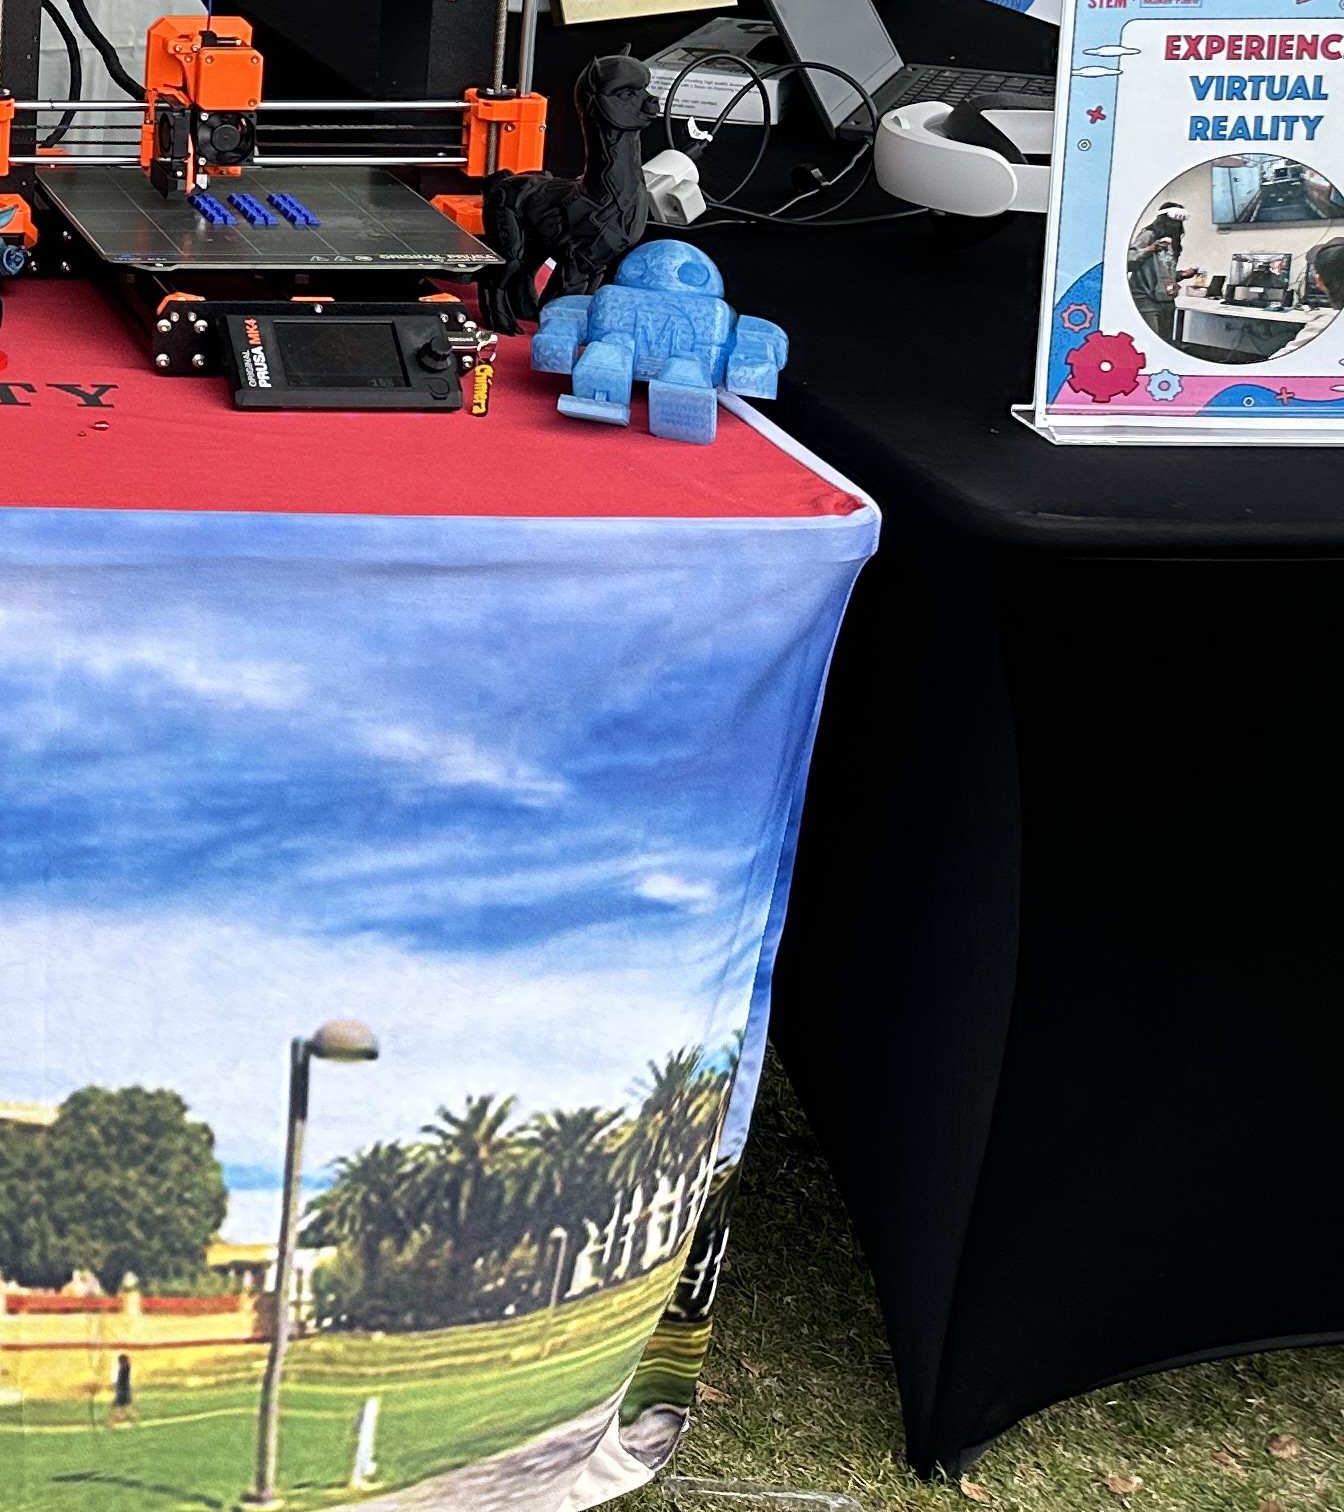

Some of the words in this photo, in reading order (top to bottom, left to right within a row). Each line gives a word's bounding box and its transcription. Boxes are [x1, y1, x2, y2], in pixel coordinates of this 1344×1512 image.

[1164, 33, 1344, 61] EXPERIENC
[1189, 74, 1330, 101] VIRTUAL
[1187, 115, 1325, 141] REALITY
[243, 317, 262, 346] MK4
[241, 349, 257, 388] ORIGINAL
[251, 345, 272, 388] PRUSA
